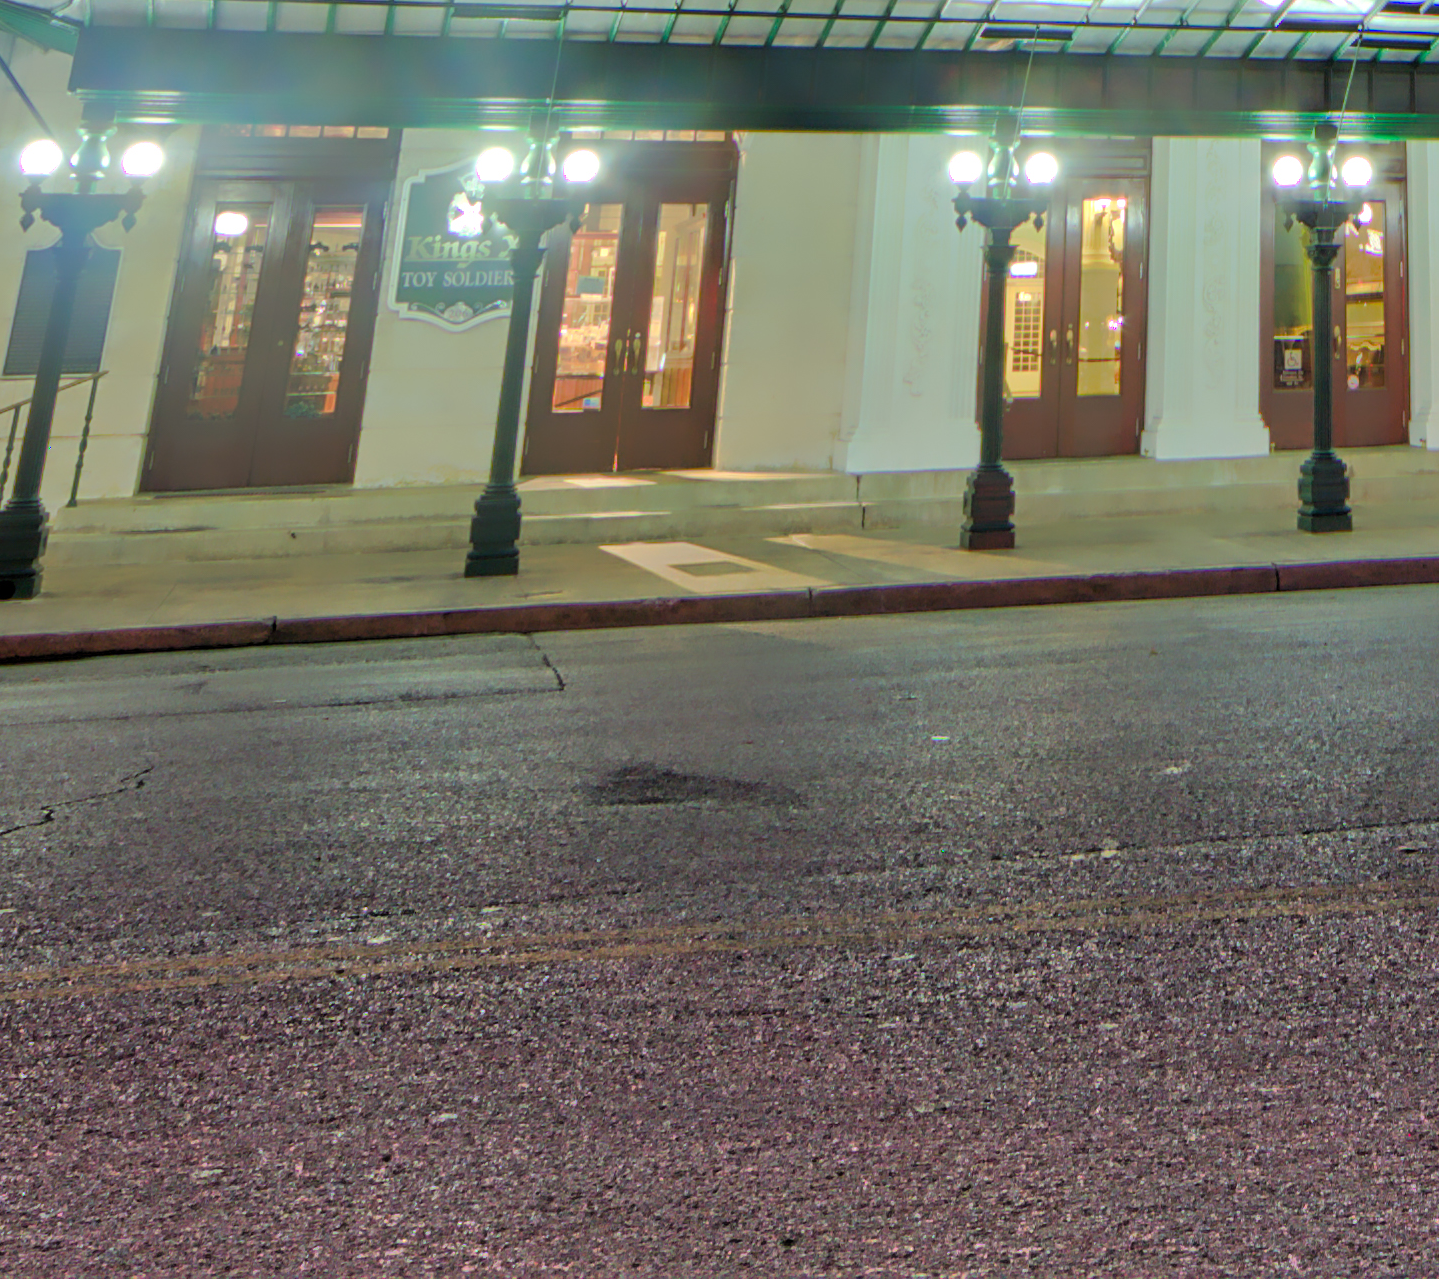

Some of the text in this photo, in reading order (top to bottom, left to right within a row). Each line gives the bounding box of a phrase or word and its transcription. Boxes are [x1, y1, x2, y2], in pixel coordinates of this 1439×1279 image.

[406, 235, 492, 268] Kings
[402, 270, 515, 287] TOY SOLDIER
